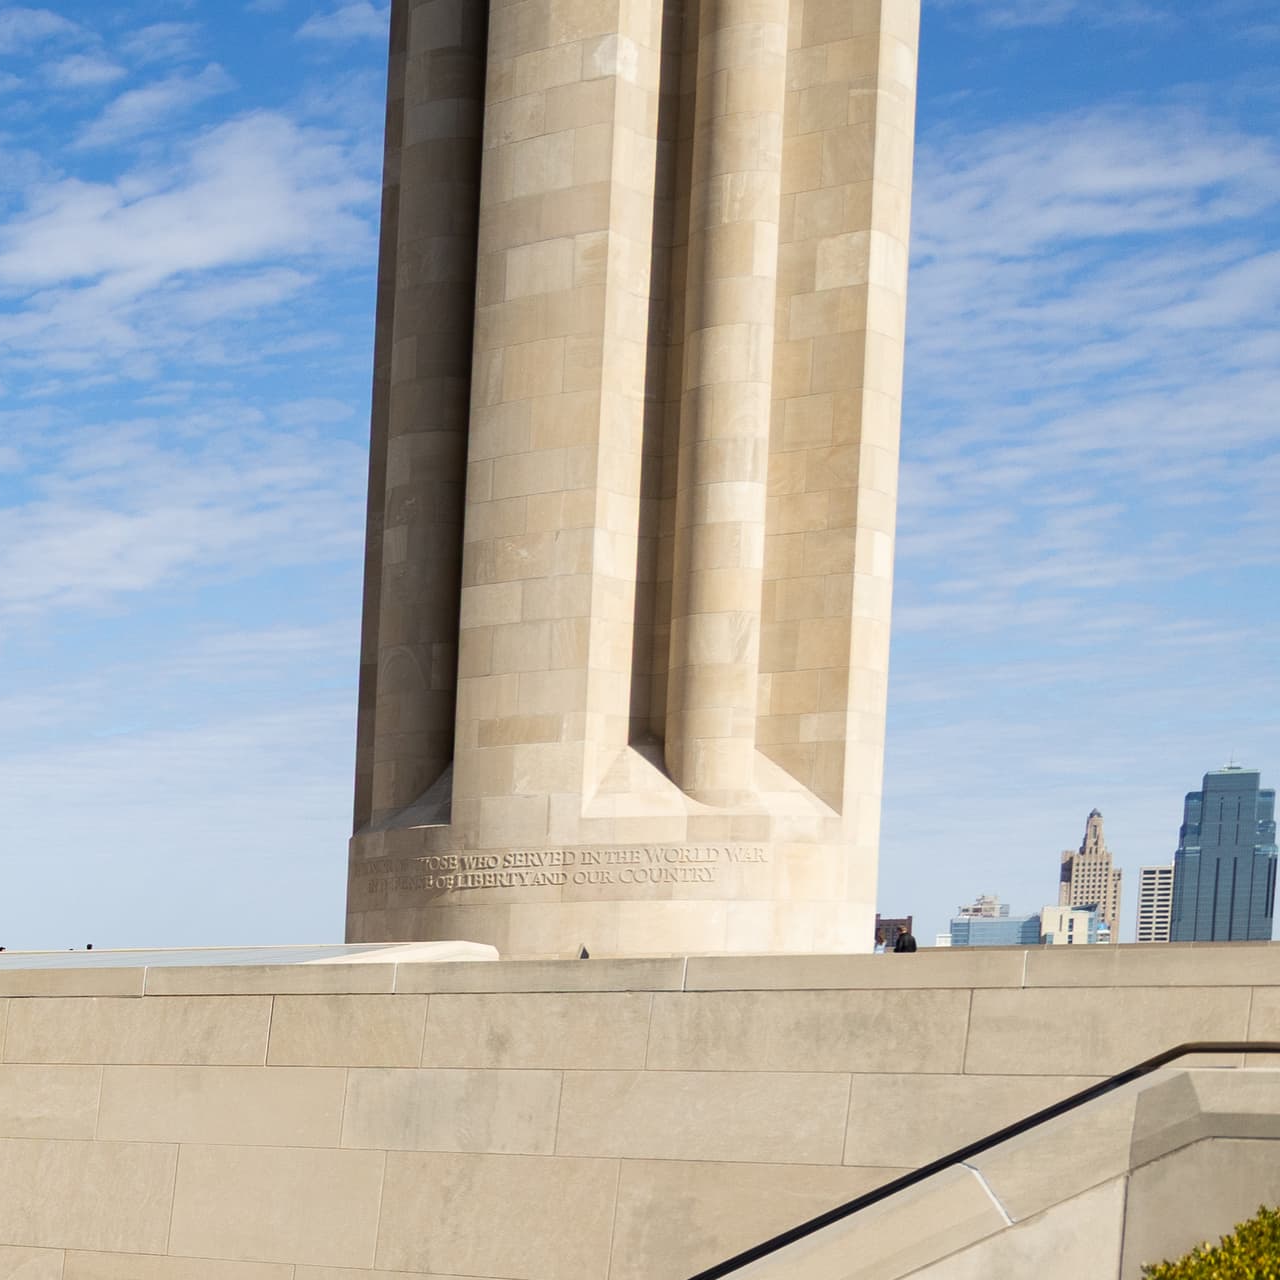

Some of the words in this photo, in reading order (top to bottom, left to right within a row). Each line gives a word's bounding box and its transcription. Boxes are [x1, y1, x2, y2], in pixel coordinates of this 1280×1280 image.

[461, 855, 499, 870] WHO
[503, 851, 575, 868] SERVED
[581, 851, 601, 865] IN
[605, 850, 640, 864] THE
[644, 848, 719, 863] WORLD
[724, 848, 768, 863] WAR
[456, 871, 529, 889] LIBERTY
[532, 872, 568, 887] AND
[572, 871, 614, 885] OUR
[618, 867, 717, 883] COUNTRY
